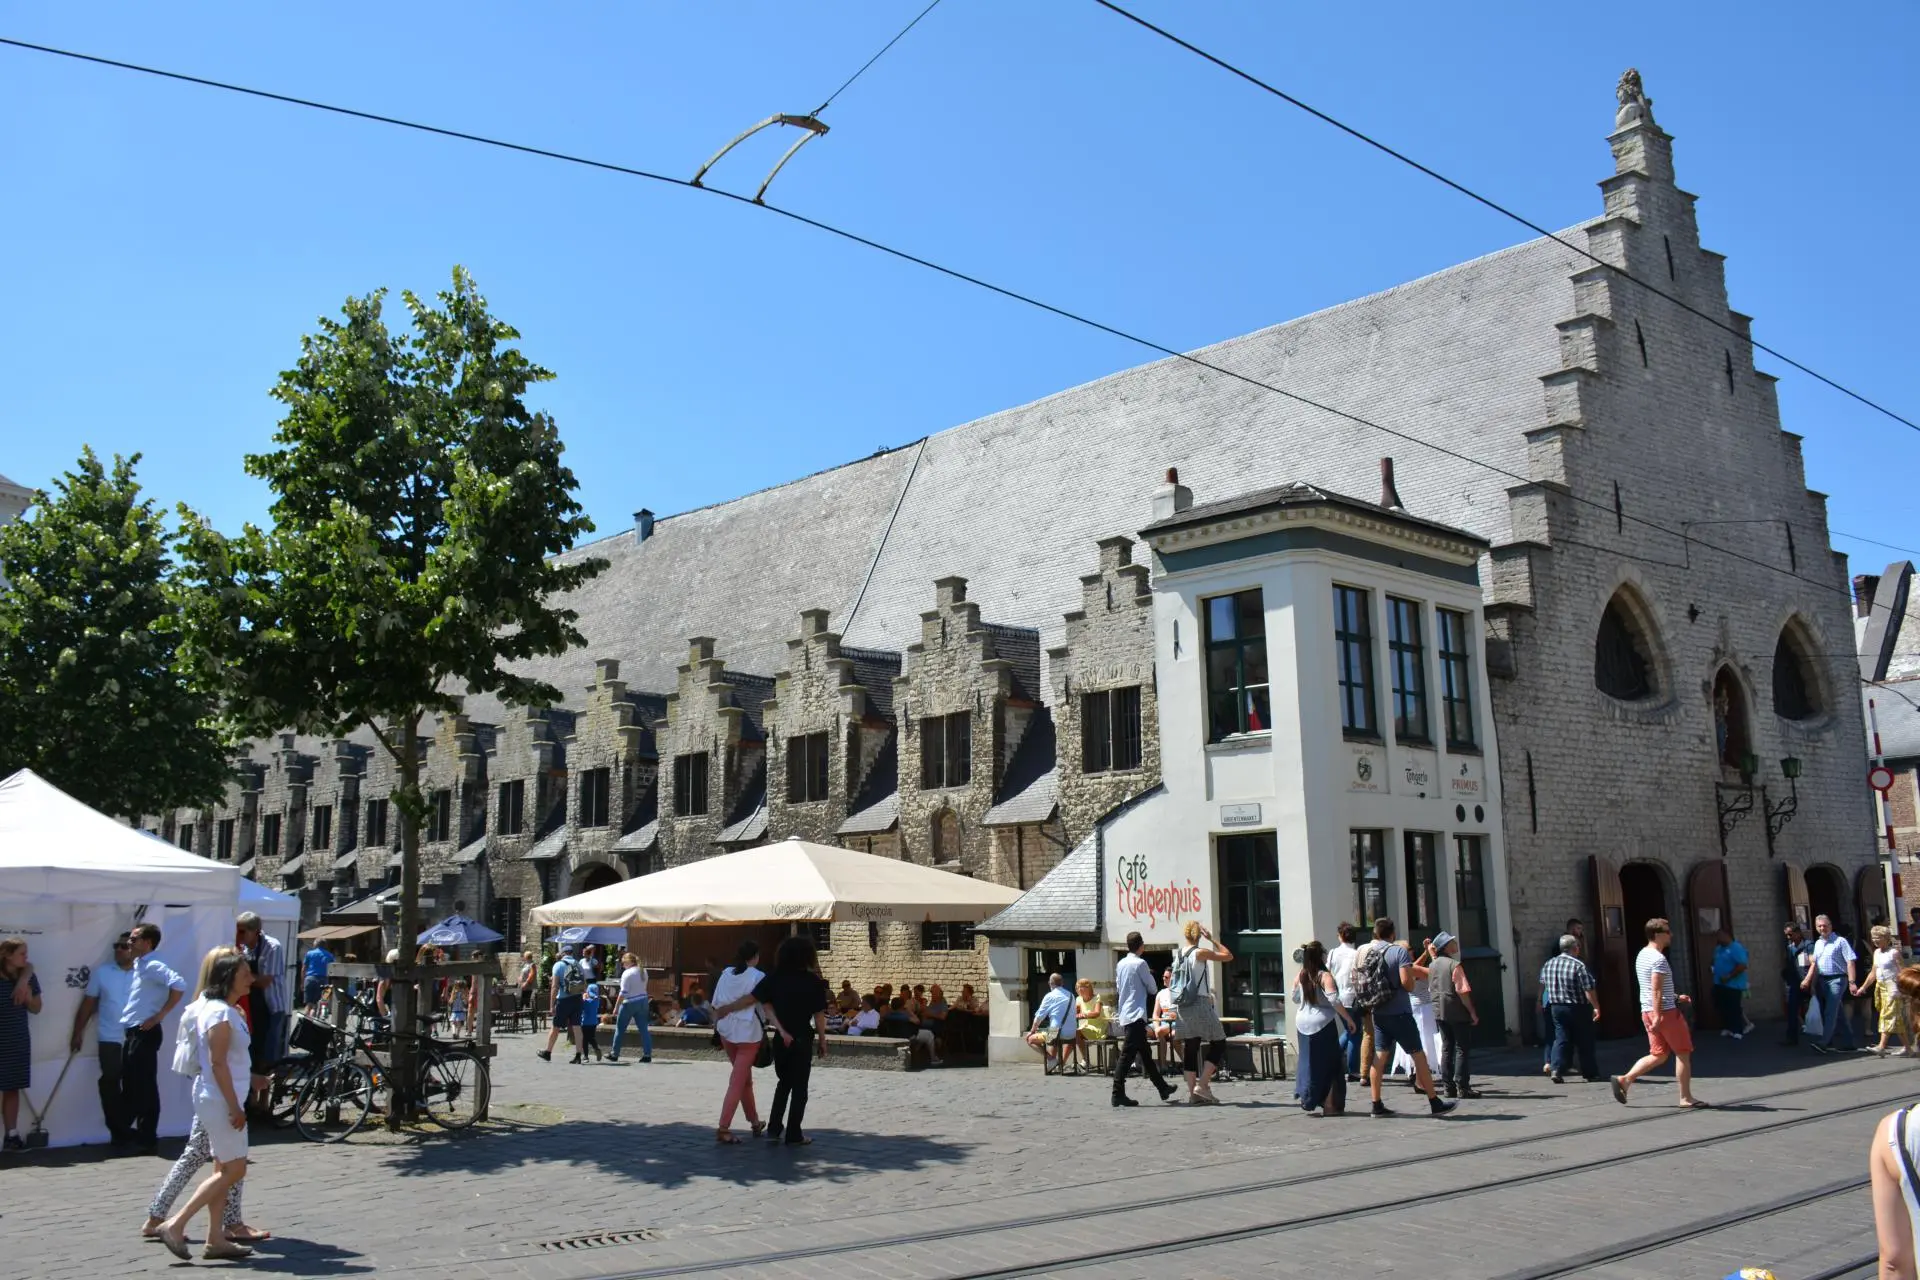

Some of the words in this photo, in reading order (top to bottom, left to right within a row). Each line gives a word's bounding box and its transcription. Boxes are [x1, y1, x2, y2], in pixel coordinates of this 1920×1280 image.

[1452, 779, 1478, 791] PRIMUS
[1118, 854, 1147, 891] Café
[774, 902, 814, 917] Galgenhuis
[1126, 879, 1201, 929] Galgenhuis
